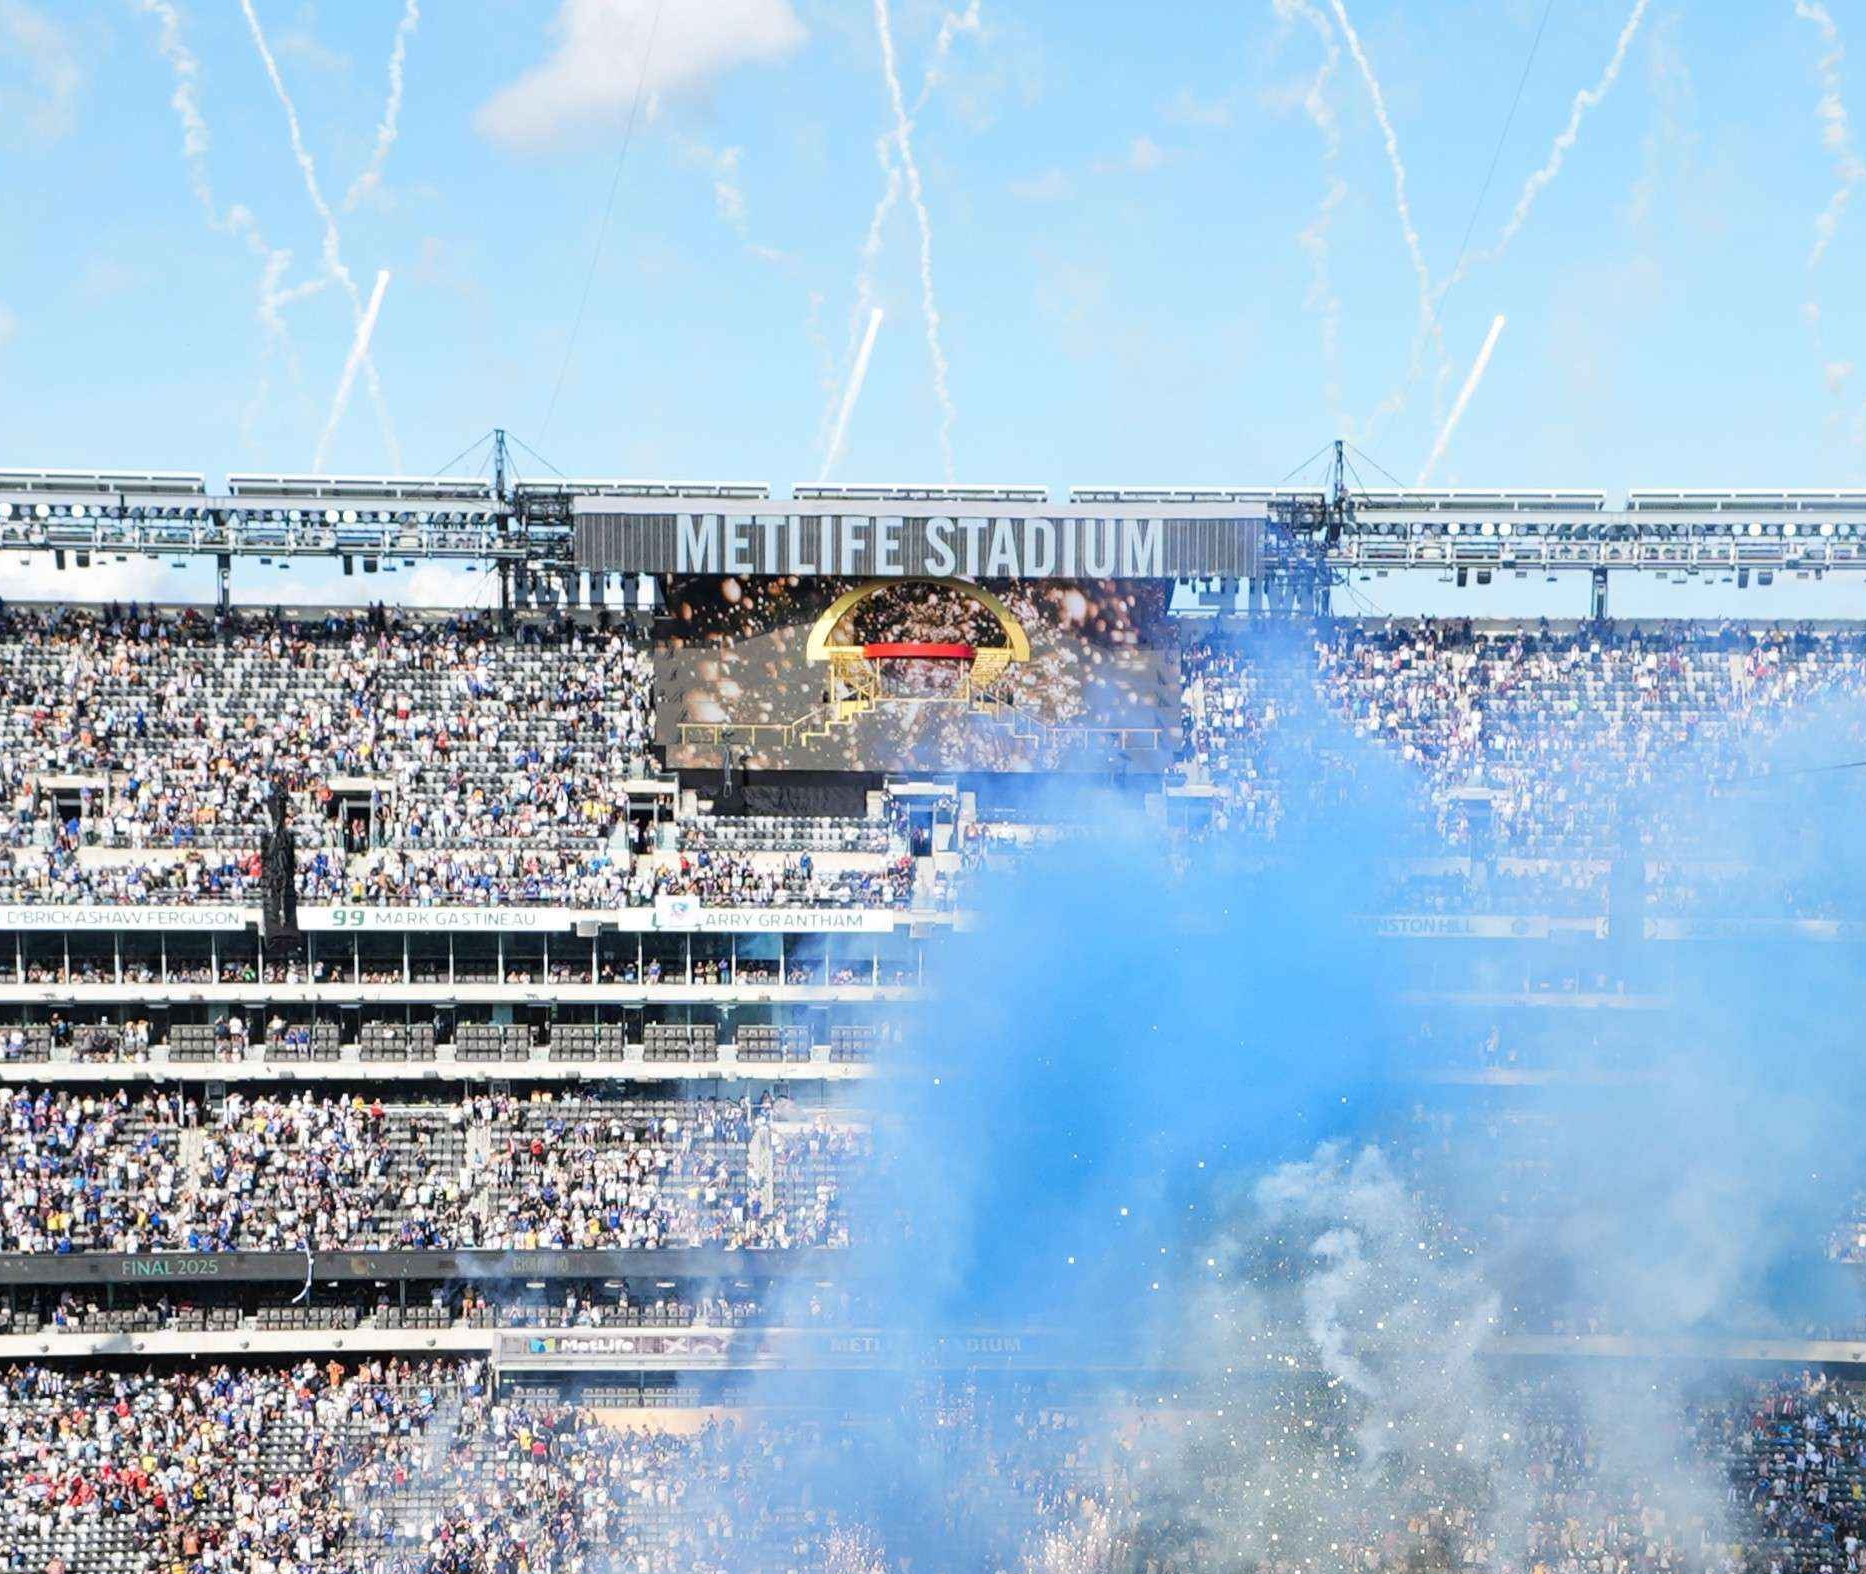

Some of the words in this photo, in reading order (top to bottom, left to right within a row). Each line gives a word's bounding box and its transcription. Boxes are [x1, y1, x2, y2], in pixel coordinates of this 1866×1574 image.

[676, 514, 901, 574] METLIFE
[924, 516, 1164, 578] STADIUM
[146, 911, 240, 926] FERGUSON
[332, 909, 365, 927] 99
[375, 911, 430, 926] MARK
[435, 911, 537, 927] GASTINEAU
[705, 913, 752, 928] ARRY
[758, 912, 863, 928] GRANTHAM
[120, 1260, 174, 1276] FINAL
[177, 1259, 220, 1275] 2025
[560, 1338, 634, 1353] MetLife
